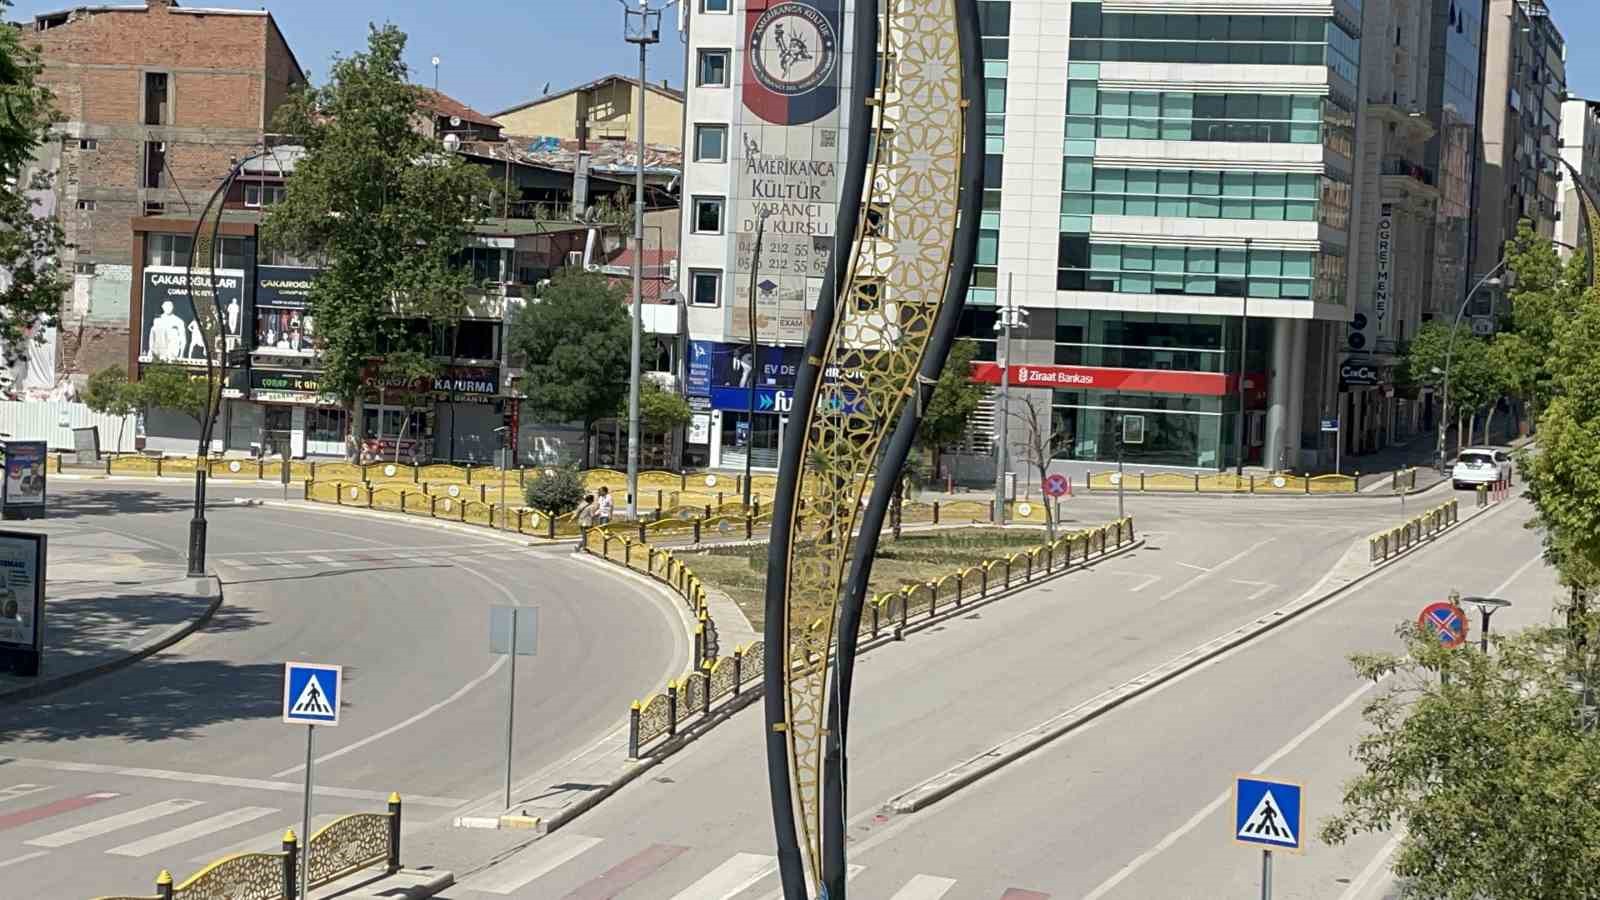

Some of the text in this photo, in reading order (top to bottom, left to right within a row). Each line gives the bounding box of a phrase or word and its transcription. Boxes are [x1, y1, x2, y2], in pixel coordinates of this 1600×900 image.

[752, 179, 821, 200] KÜLTÜR
[752, 201, 821, 217] YABANCI
[773, 220, 828, 235] KURSU
[769, 242, 788, 253] 212
[794, 243, 808, 256] 55
[768, 258, 787, 269] 212
[793, 260, 807, 272] 55
[764, 364, 778, 375] EV
[780, 365, 796, 376] DE
[1030, 370, 1094, 384] Ziraat Bankası
